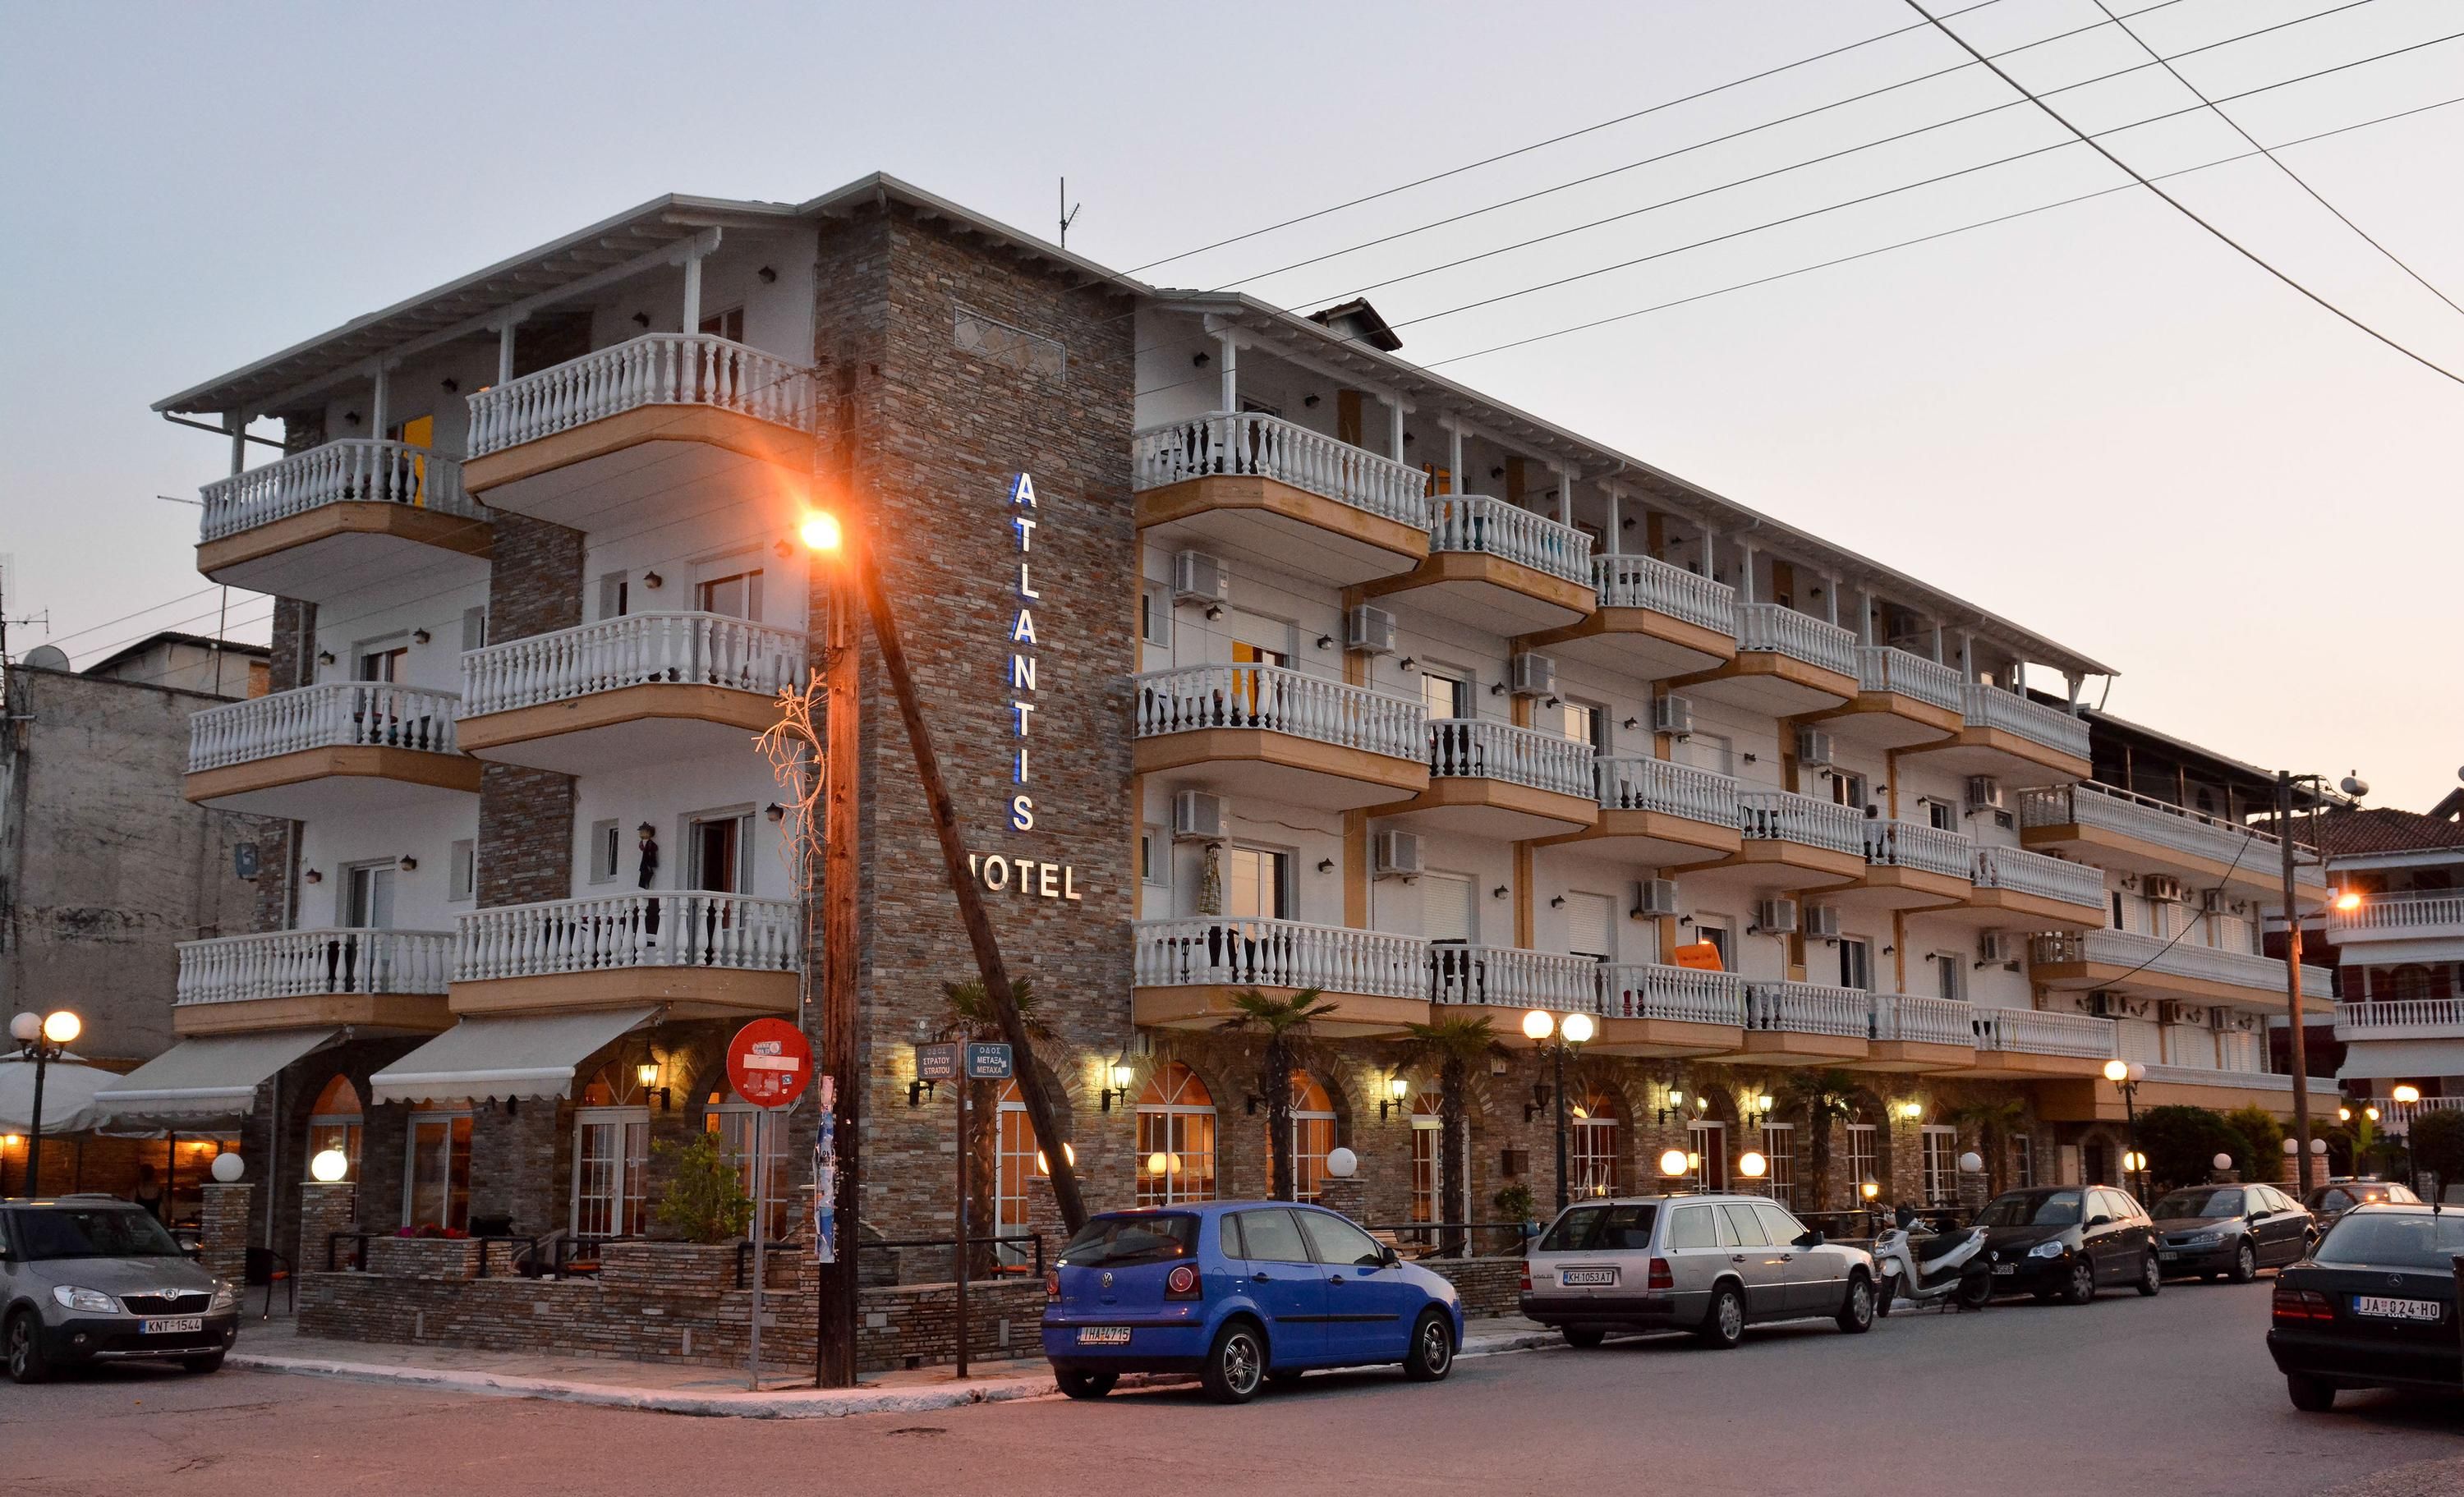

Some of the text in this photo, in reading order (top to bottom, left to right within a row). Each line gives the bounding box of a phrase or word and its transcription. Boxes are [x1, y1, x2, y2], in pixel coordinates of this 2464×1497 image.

[1013, 472, 1039, 831] ATLANTIS
[923, 1057, 950, 1065] ΣΤΡΑΤΟΥ
[977, 1056, 1002, 1064] ΜΕΤΑΞΑ
[924, 1066, 950, 1075] STRATOU
[977, 1066, 1002, 1074] METAXA
[1582, 1273, 1599, 1281] 1053
[1601, 1273, 1611, 1281] AT
[2364, 1298, 2379, 1312] JA
[149, 1320, 200, 1332] KNT-1544
